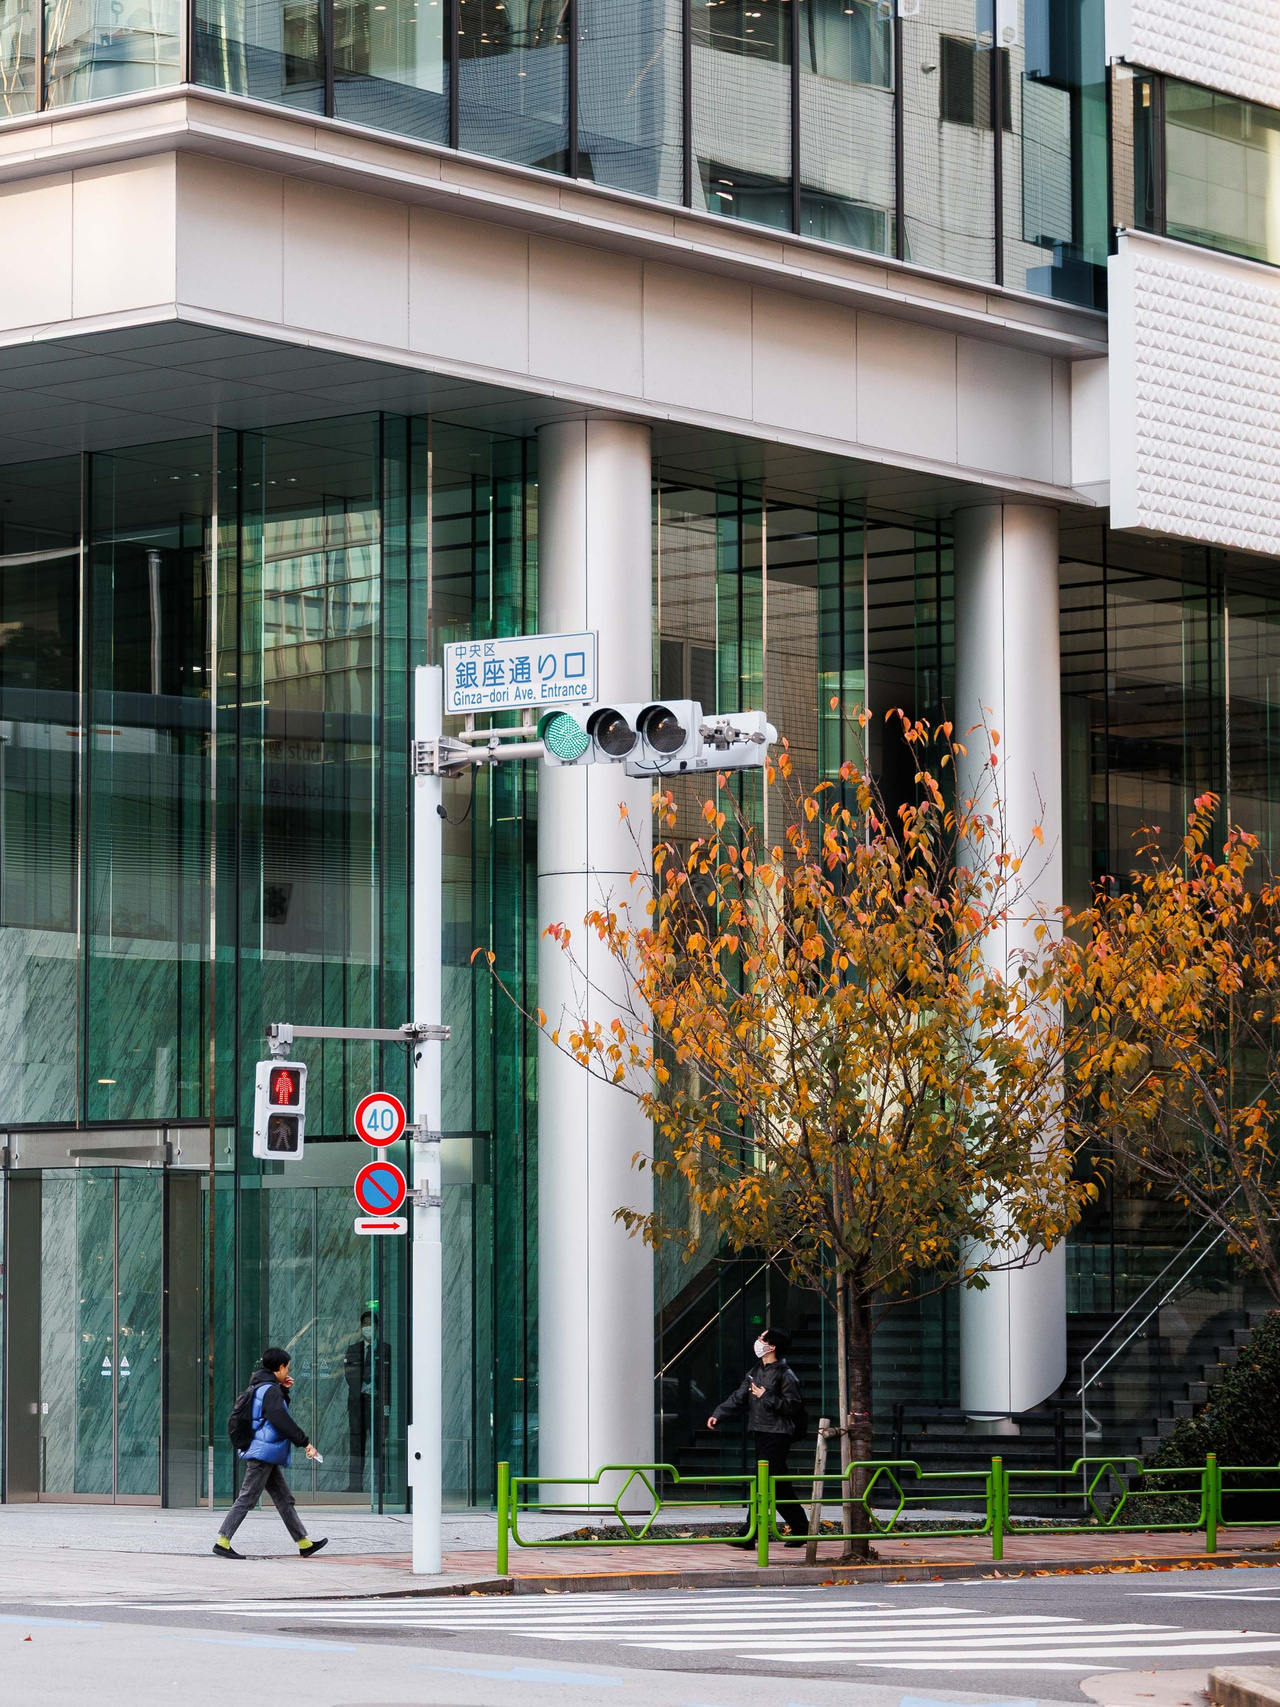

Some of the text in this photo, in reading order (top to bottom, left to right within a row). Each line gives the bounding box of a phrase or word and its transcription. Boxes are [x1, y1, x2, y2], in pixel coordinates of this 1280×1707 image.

[455, 642, 495, 659] 中央区
[455, 652, 586, 689] 銀座通り口
[453, 683, 587, 706] Ginza-dori Ave. Entrance
[367, 1108, 394, 1132] 40
